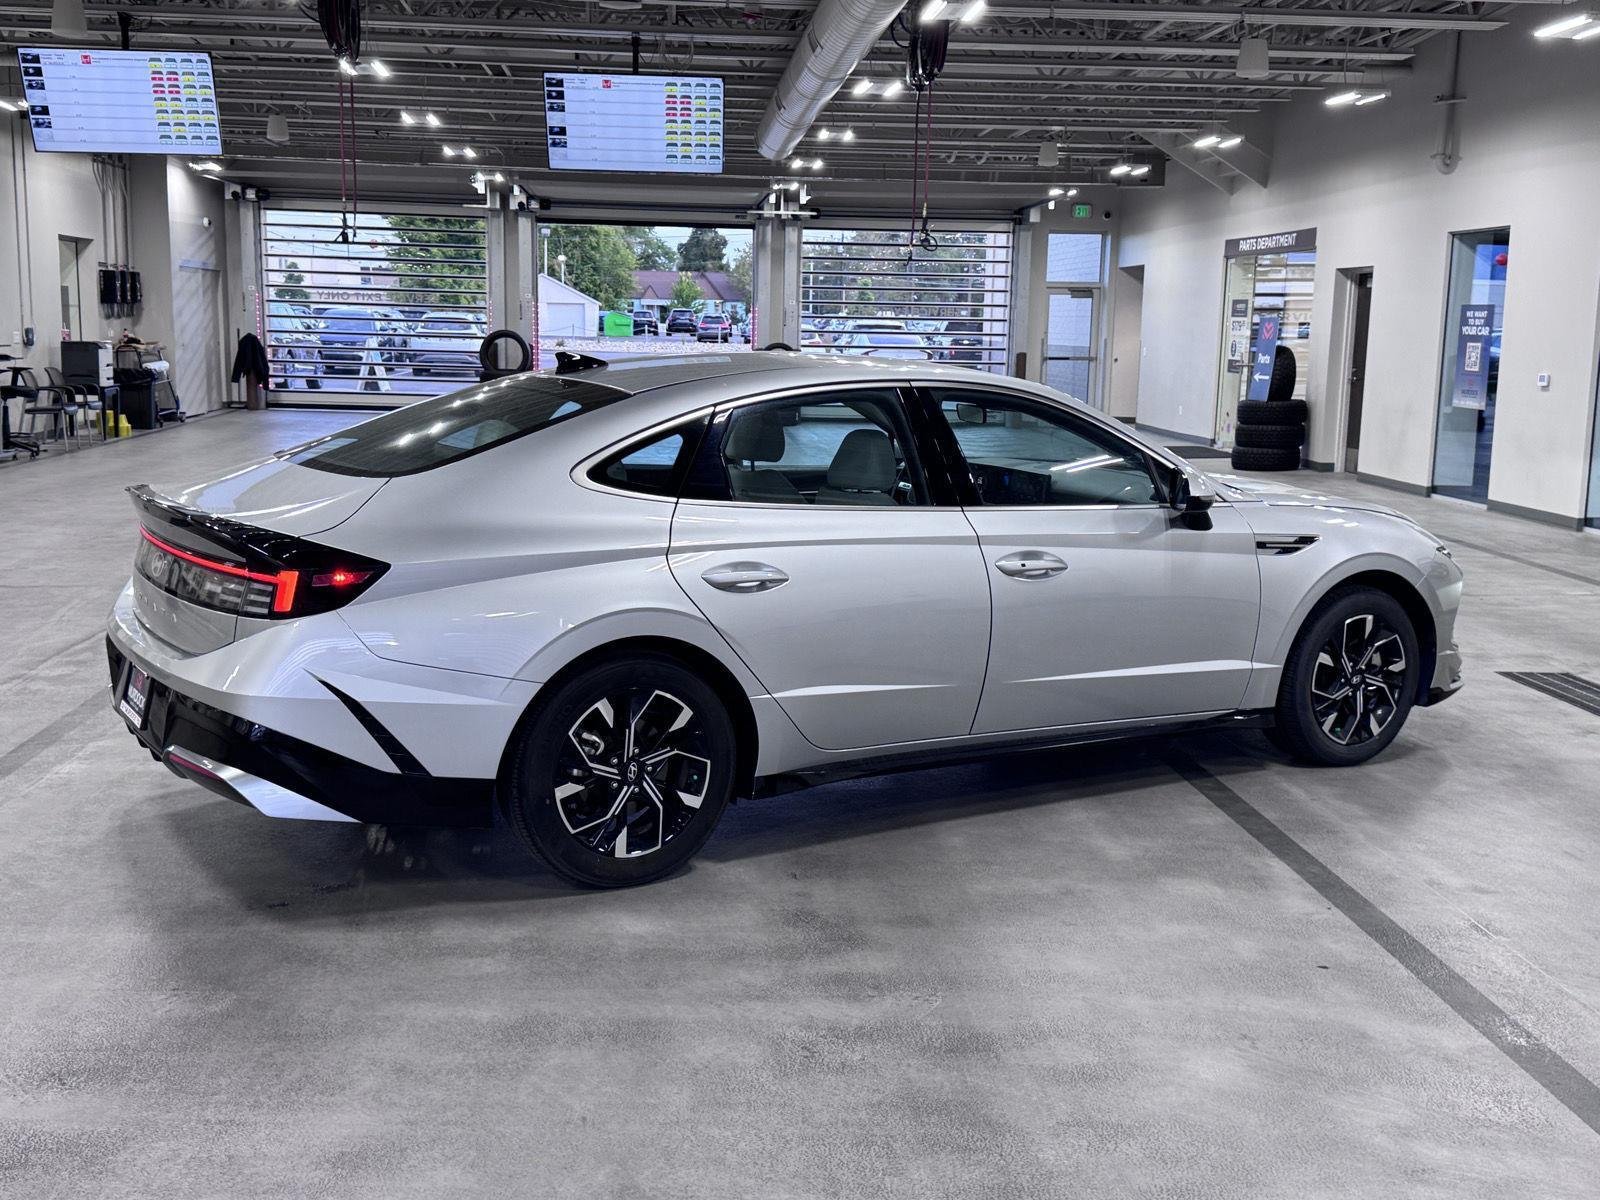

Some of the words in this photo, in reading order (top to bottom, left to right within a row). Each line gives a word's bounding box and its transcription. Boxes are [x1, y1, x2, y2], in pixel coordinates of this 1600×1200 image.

[1239, 238, 1257, 251] PARTS
[1257, 233, 1297, 249] DEPARTMENT
[1474, 310, 1488, 318] WANT
[1468, 318, 1475, 326] TO
[1462, 326, 1477, 336] YOUR
[1477, 326, 1490, 336] CAR
[1258, 353, 1270, 364] Parts
